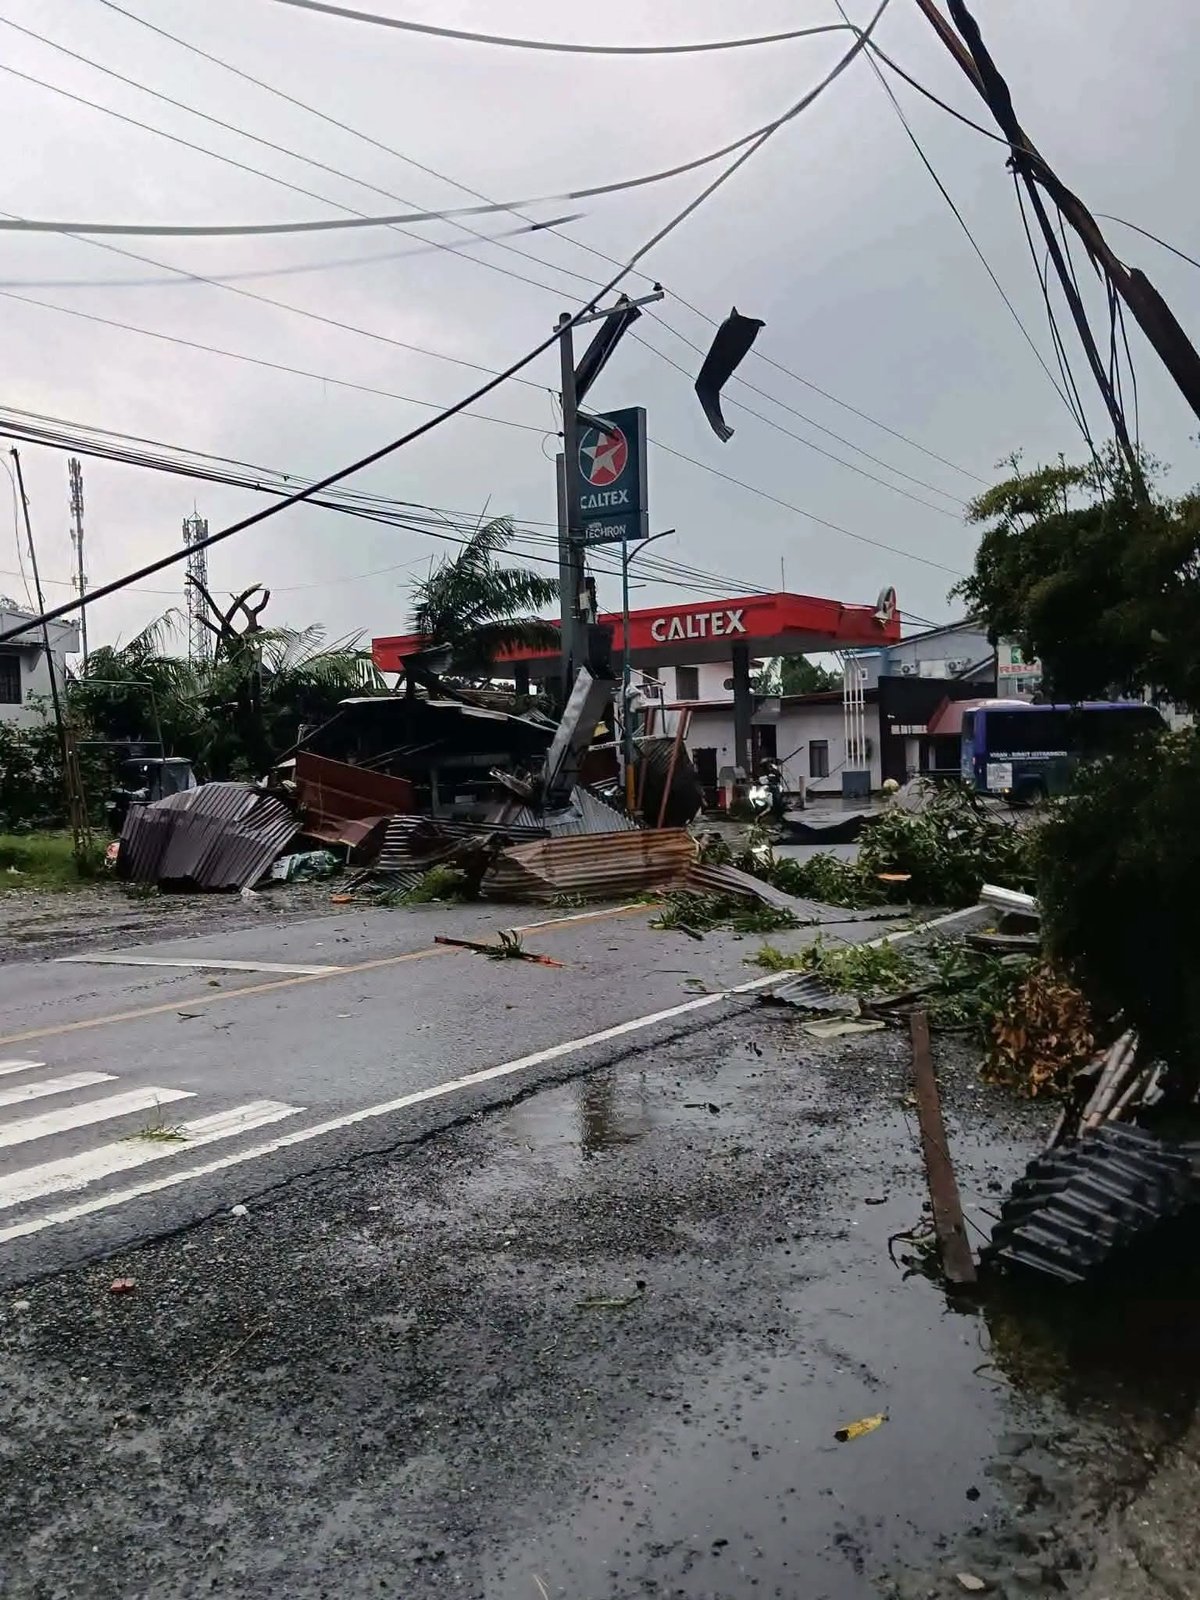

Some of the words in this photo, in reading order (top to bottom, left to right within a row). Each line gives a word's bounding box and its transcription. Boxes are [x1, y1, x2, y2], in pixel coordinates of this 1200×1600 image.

[580, 489, 630, 509] CALTEX
[585, 524, 627, 539] TECHRON
[651, 609, 747, 642] CALTEX
